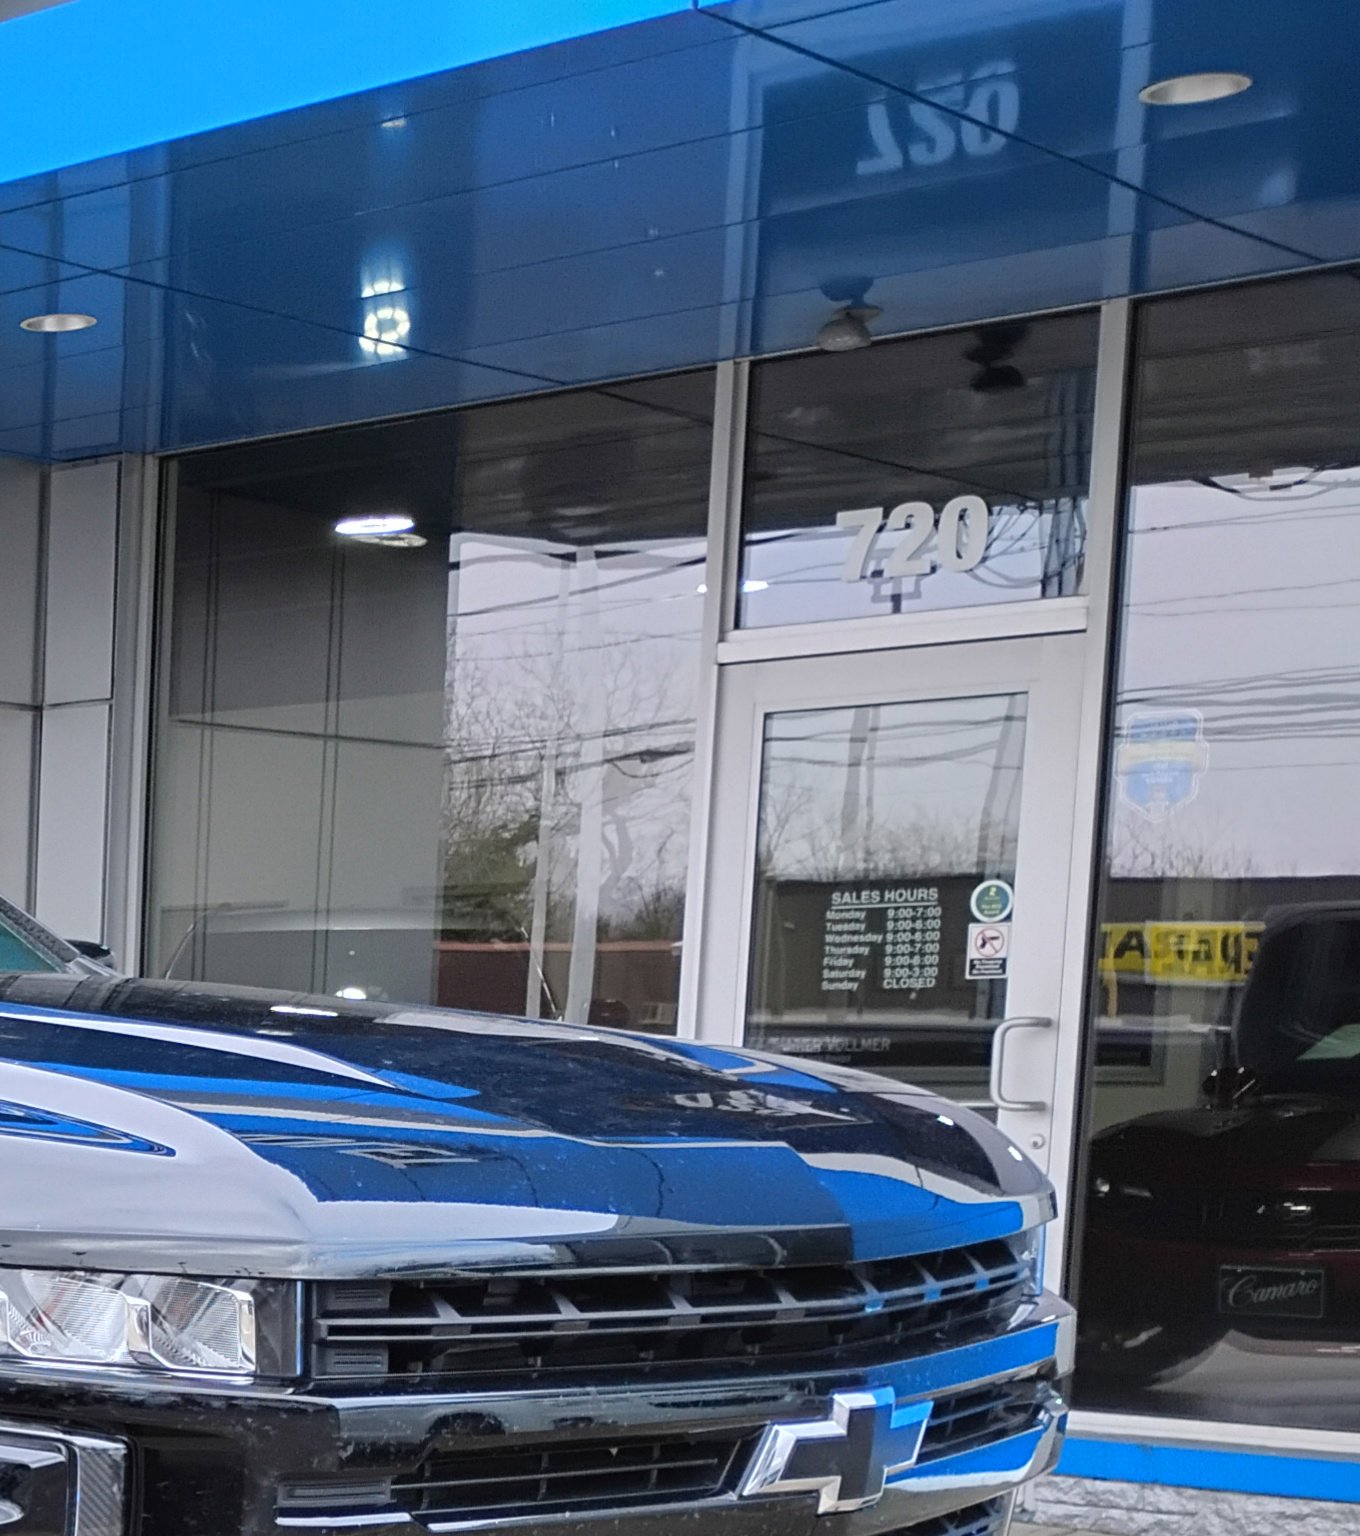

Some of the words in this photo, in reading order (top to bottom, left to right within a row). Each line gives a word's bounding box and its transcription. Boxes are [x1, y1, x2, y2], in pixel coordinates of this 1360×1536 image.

[836, 495, 989, 583] 720
[831, 889, 880, 905] SALES
[884, 887, 938, 902] HOURS
[826, 910, 866, 920] Monday
[887, 907, 941, 919] 9:00-7:00
[826, 922, 866, 932] Tuesday
[825, 933, 883, 943] Wednesday
[825, 945, 870, 955] Thursday
[885, 943, 939, 955] 9:00-7:00
[823, 956, 855, 967] Friday
[822, 969, 867, 979] Saturday
[821, 981, 859, 991] Sunday
[883, 978, 936, 989] CLOSED
[1227, 1275, 1320, 1308] Camaro
